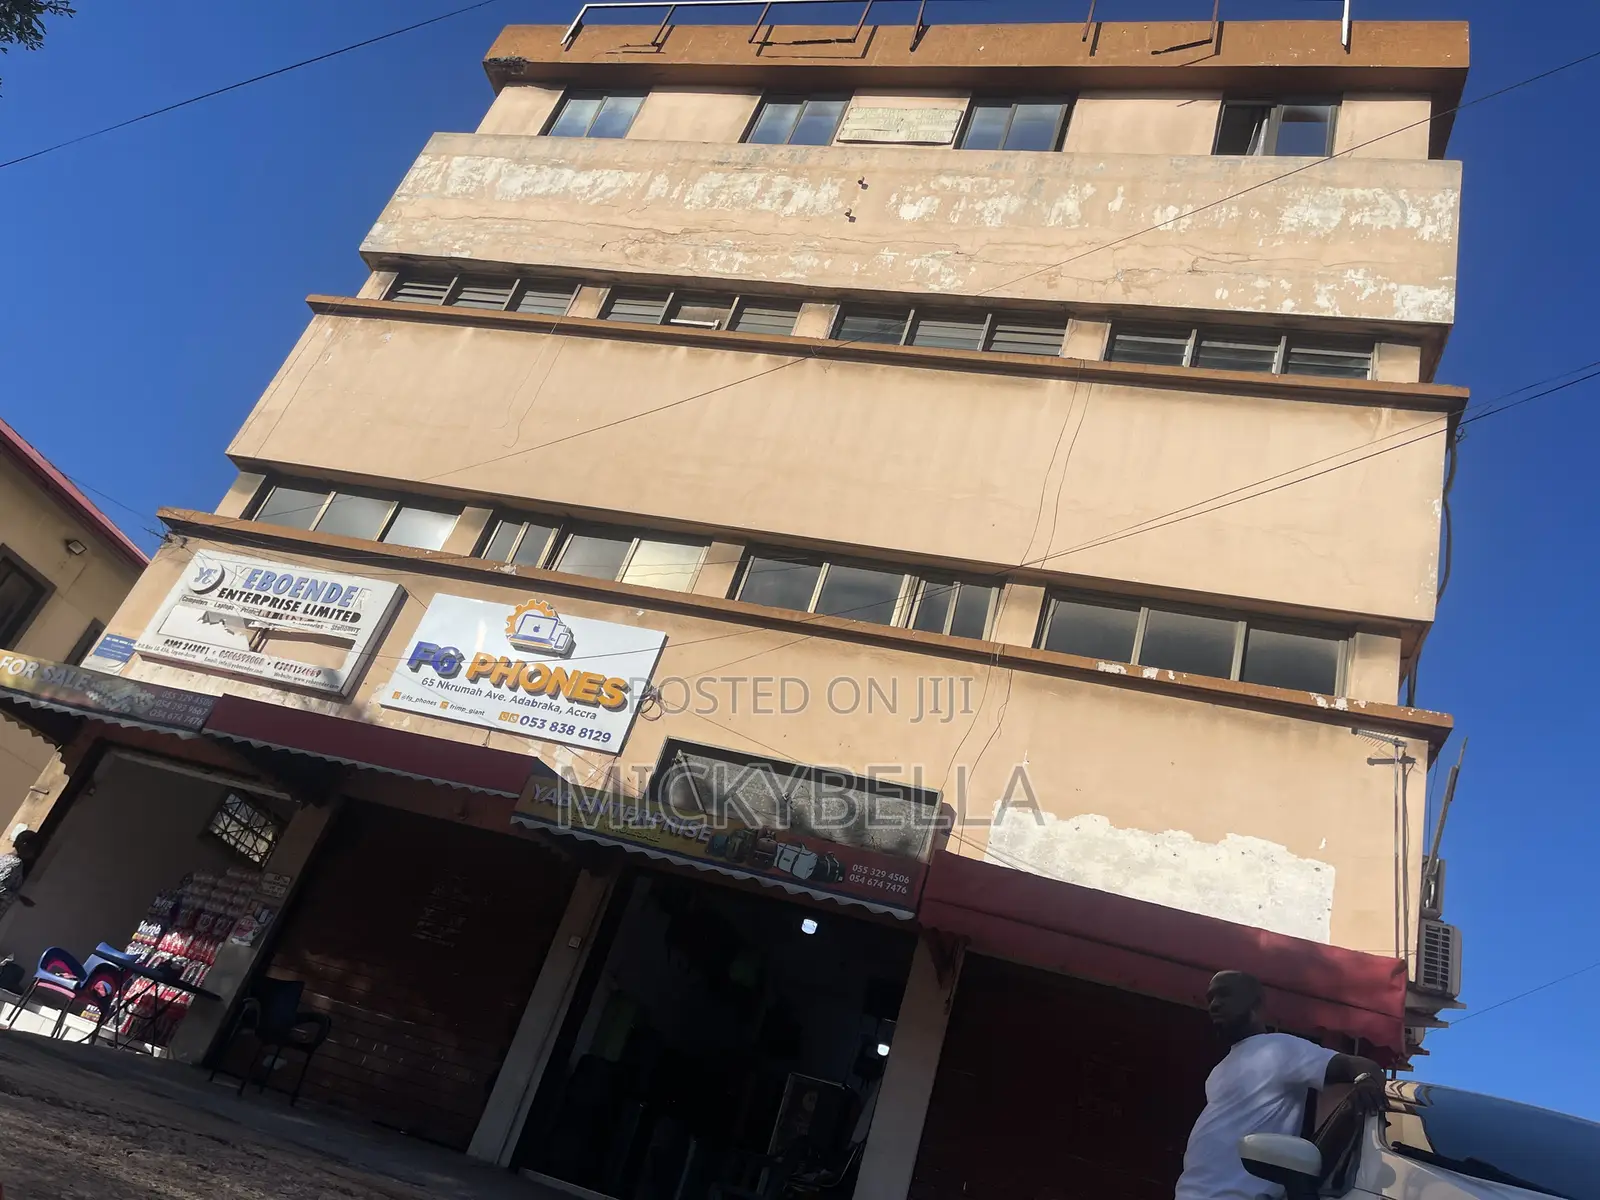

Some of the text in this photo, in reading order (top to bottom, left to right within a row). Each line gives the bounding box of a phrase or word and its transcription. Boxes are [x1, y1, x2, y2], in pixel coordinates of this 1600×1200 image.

[181, 596, 208, 606] Computers
[214, 602, 235, 611] Laptops
[217, 588, 362, 624] ENTERPRISE LIMITED
[0, 655, 92, 691] FOR SALE
[465, 651, 631, 709] PHONES
[401, 694, 485, 717] @fg_phones frimp_giant
[421, 677, 597, 720] 65 Nkrumah Ave. Adabraka, Accra
[519, 715, 612, 743] 053 838 8129
[578, 796, 714, 842] ENTERPRISE
[849, 873, 907, 894] 054 674 7476
[852, 864, 910, 884] 055 329 4506
